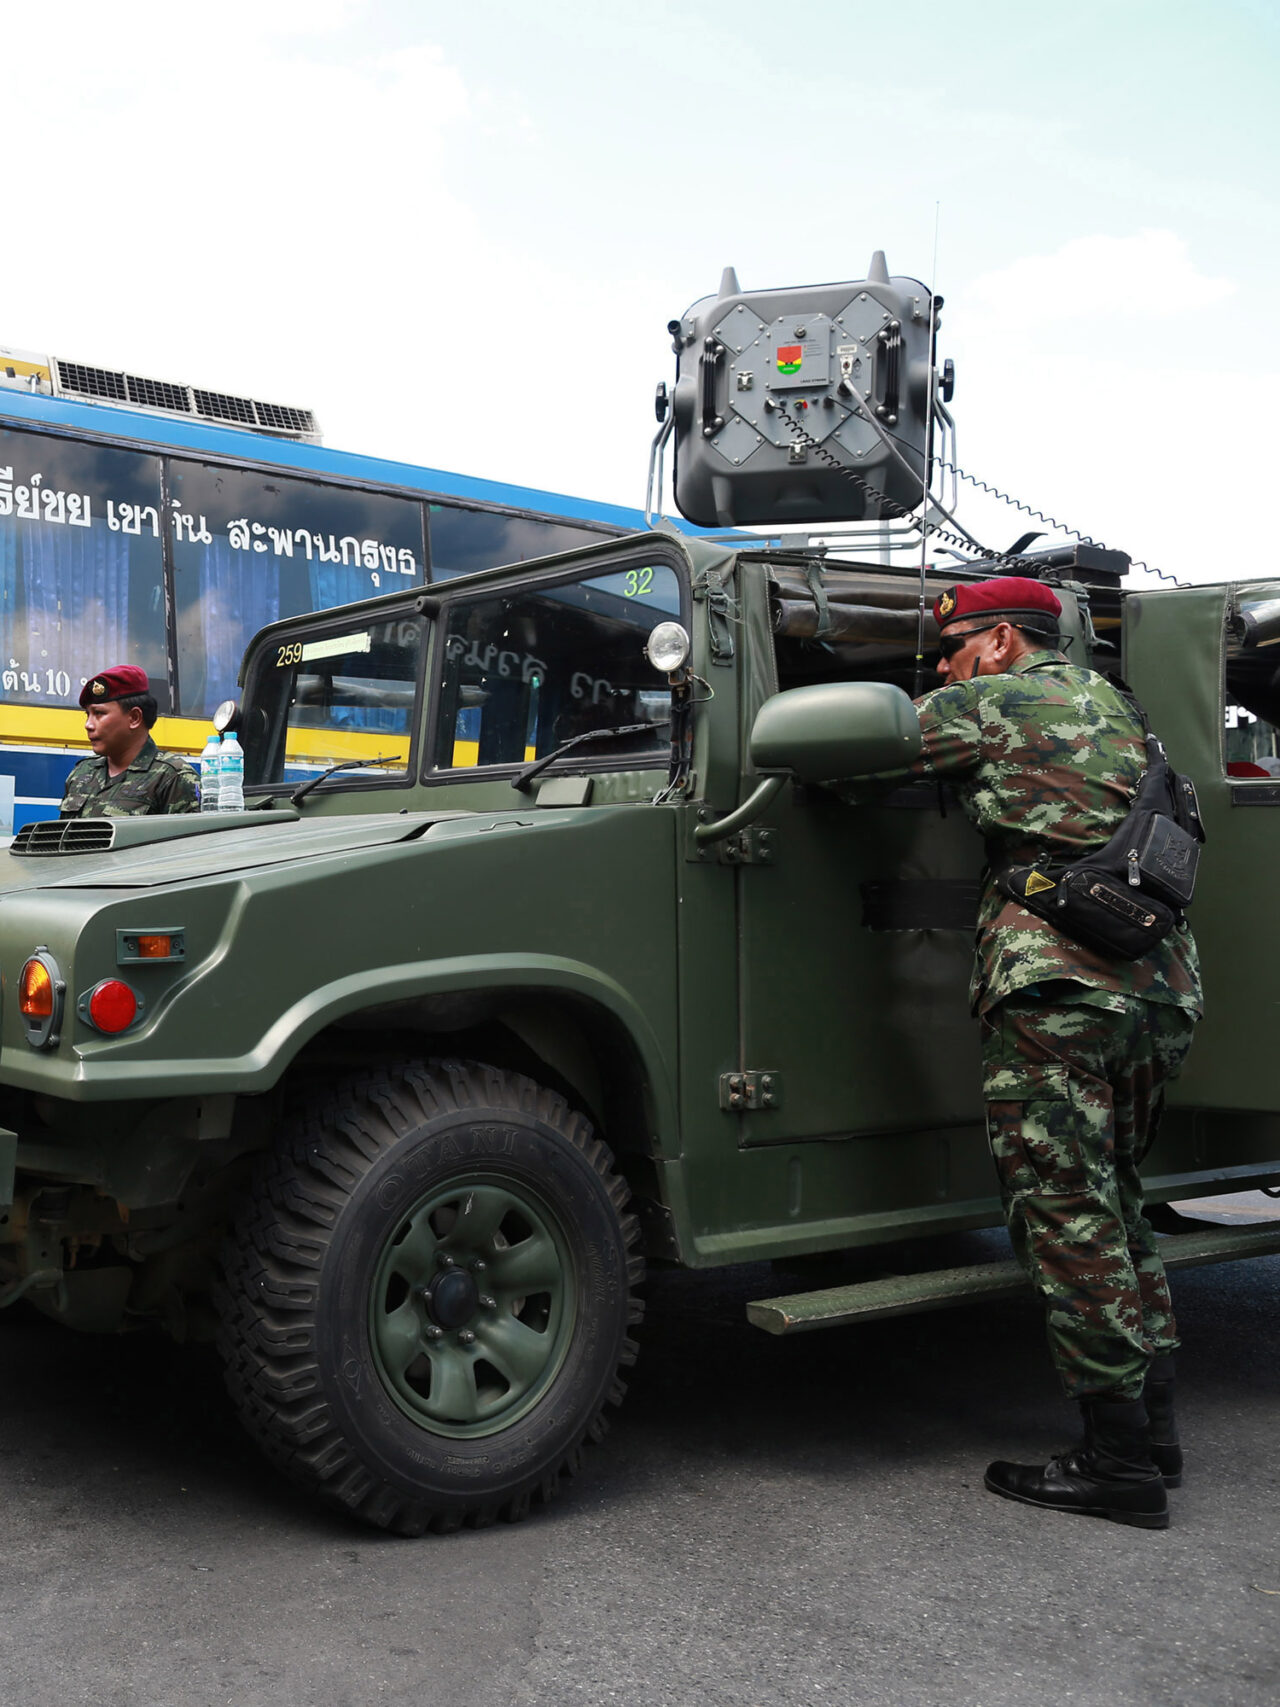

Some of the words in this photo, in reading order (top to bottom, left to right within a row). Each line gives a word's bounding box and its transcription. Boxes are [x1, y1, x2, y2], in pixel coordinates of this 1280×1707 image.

[226, 517, 417, 588] สะพานกรุงธ
[622, 566, 655, 598] 32
[275, 642, 303, 667] 259
[46, 669, 71, 697] 10
[376, 1126, 520, 1211] OTANI
